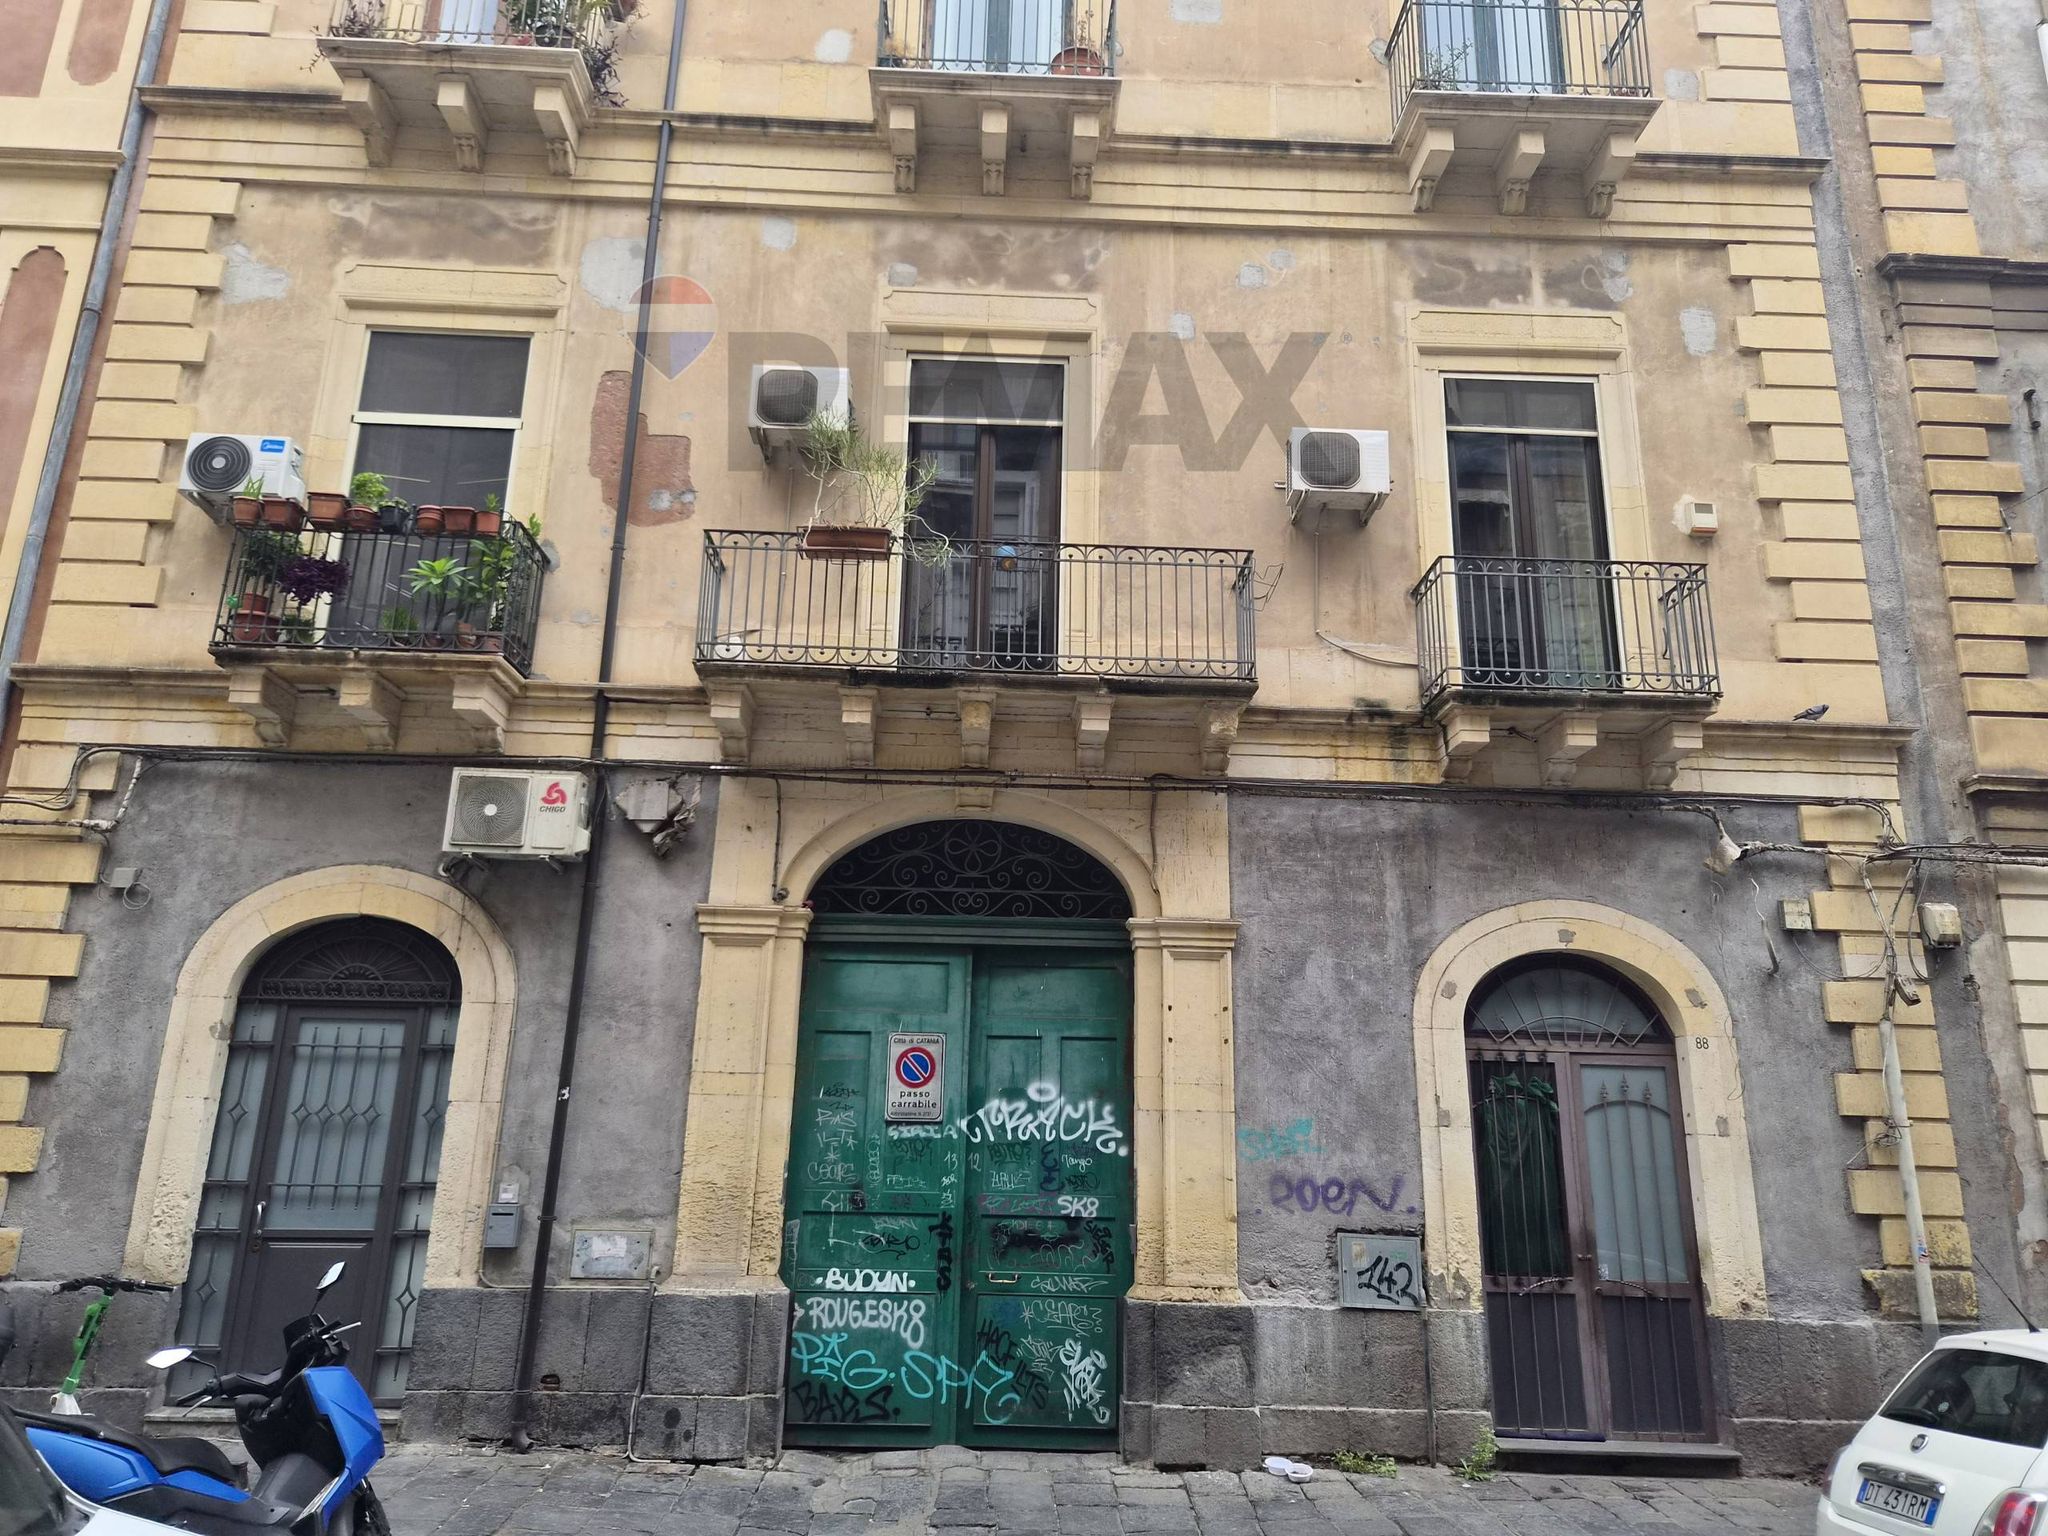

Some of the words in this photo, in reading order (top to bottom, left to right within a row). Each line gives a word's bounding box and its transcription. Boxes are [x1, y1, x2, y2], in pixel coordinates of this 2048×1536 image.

[539, 805, 566, 813] CHIGO
[1695, 1037, 1709, 1049] 88
[899, 1090, 930, 1099] passo
[891, 1100, 937, 1109] carrabile
[1057, 1195, 1100, 1218] SK8
[1865, 1482, 1882, 1504] DT
[1883, 1488, 1929, 1520] 431RM
